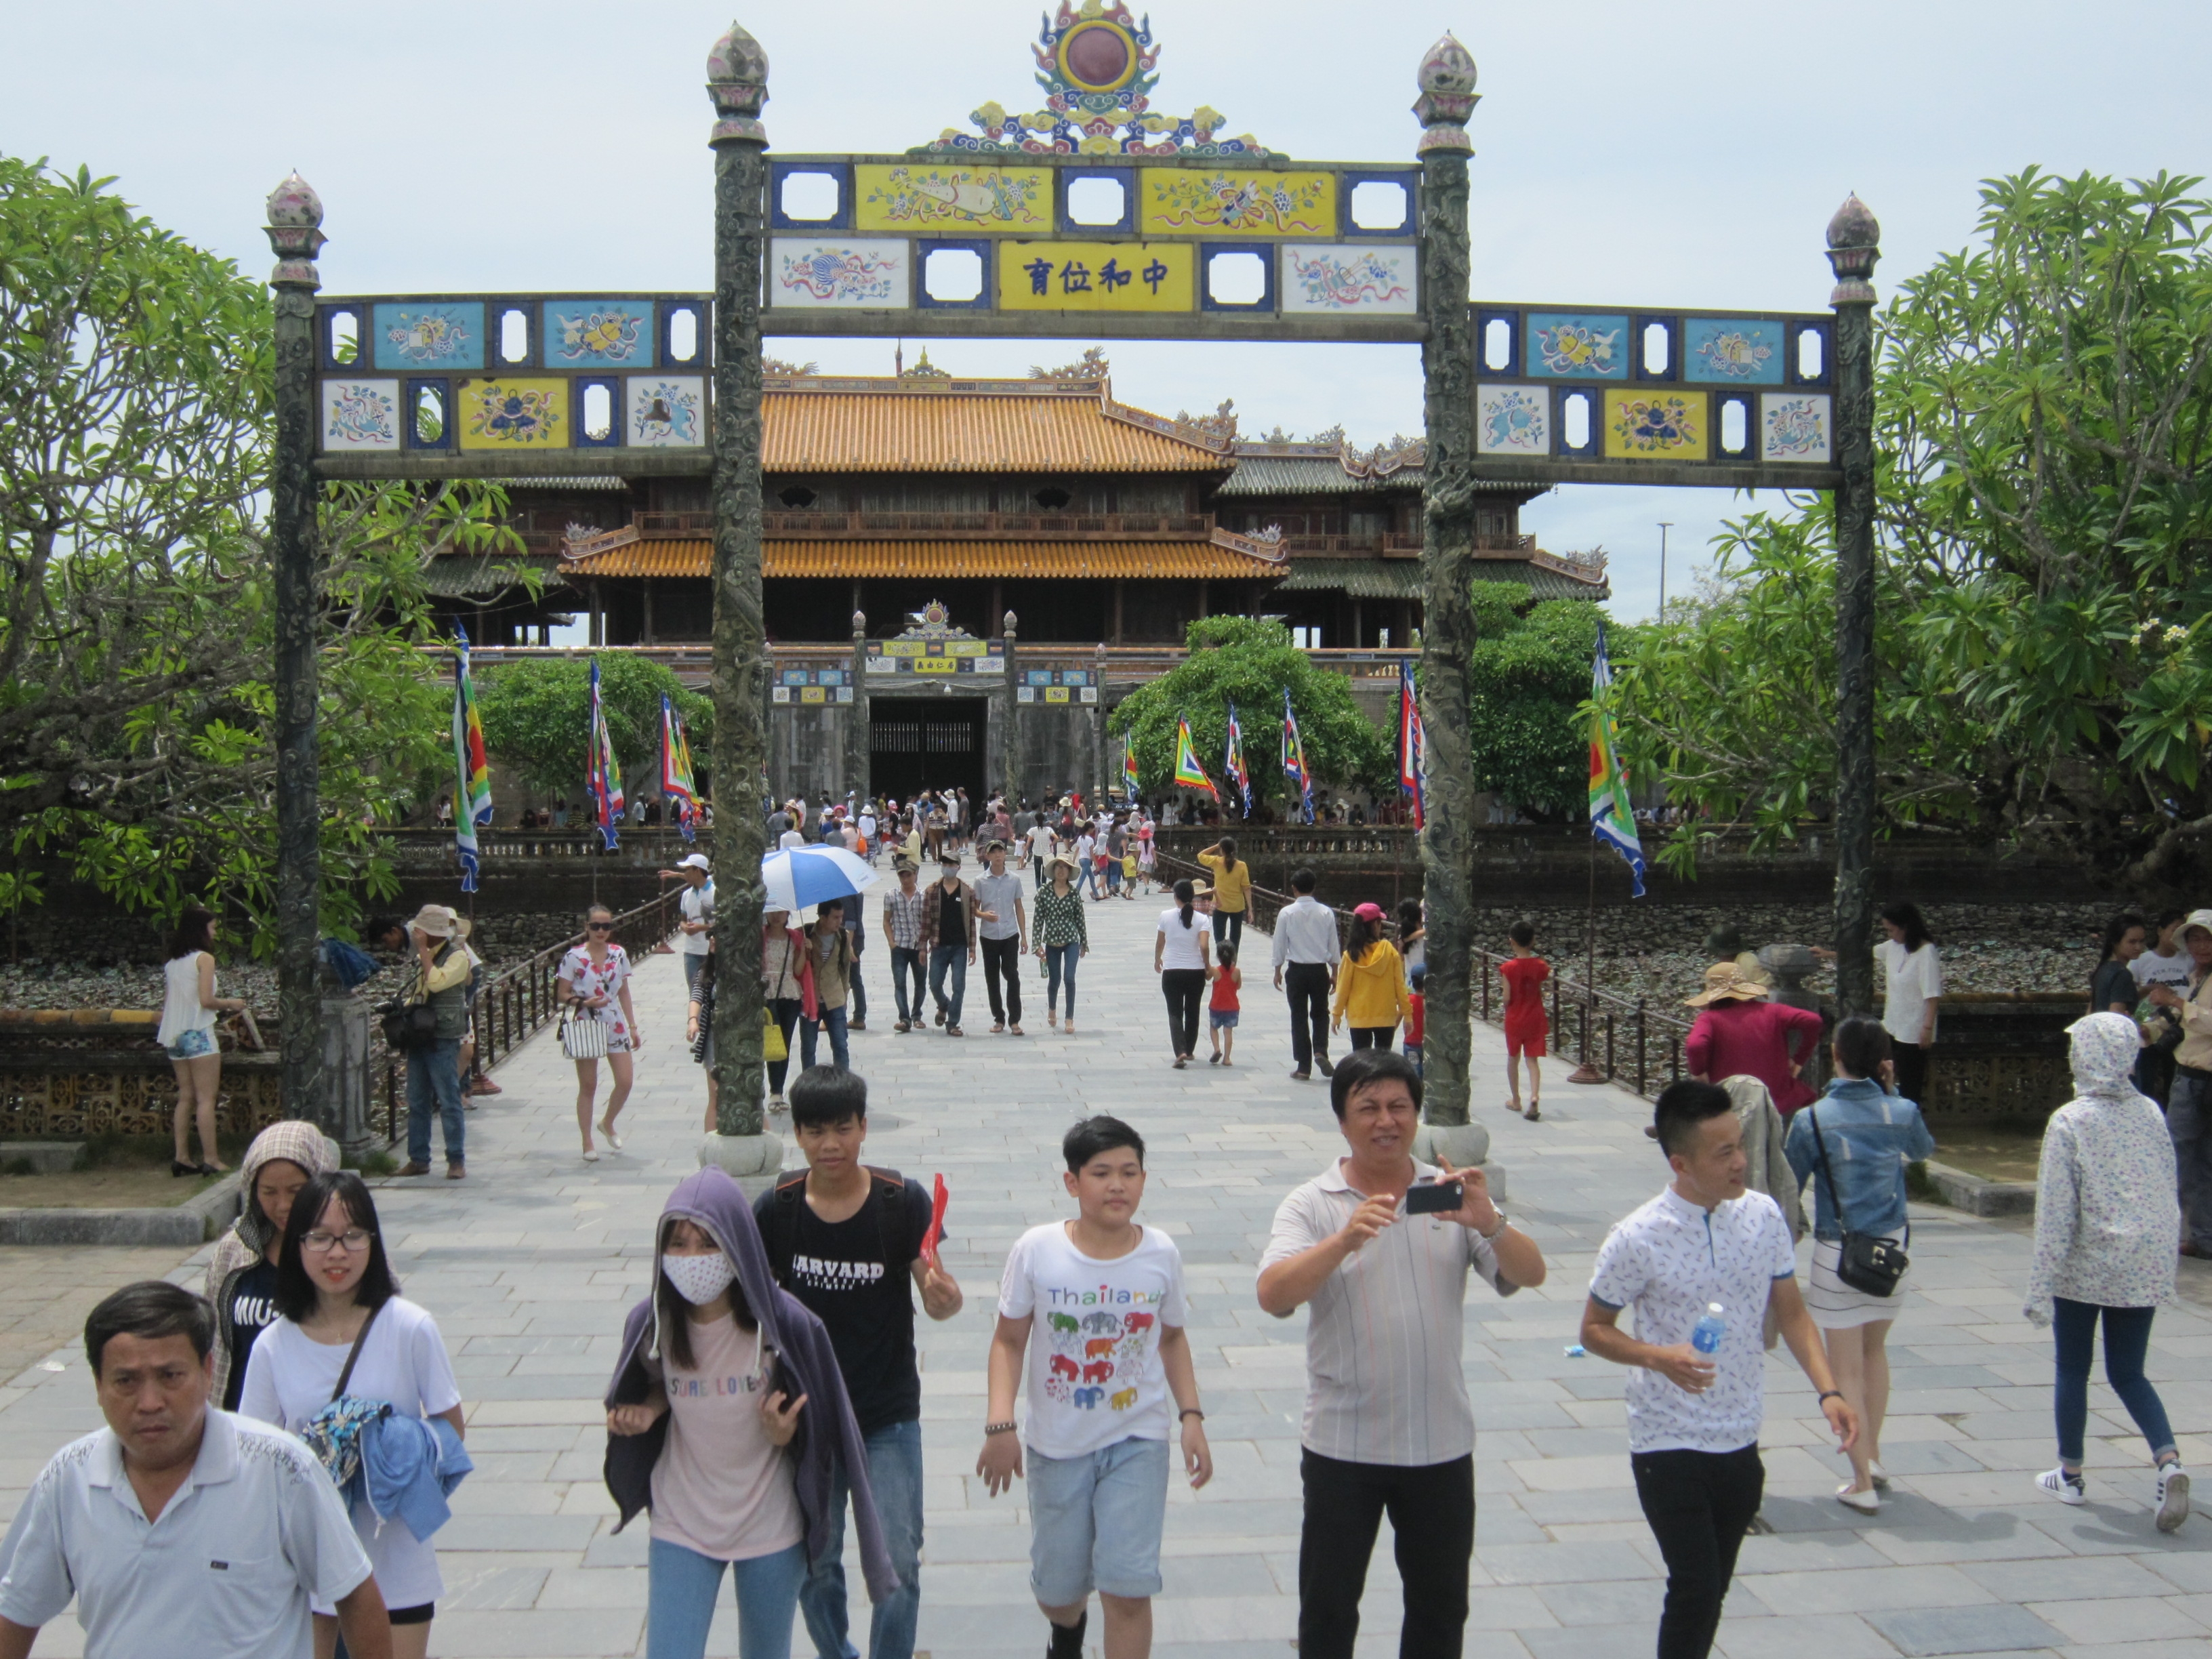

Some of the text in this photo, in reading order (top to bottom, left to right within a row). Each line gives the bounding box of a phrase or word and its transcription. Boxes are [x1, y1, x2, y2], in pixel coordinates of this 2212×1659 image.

[792, 1254, 884, 1279] ARVARD
[792, 1269, 877, 1286] NIVERSITY
[1048, 1284, 1162, 1307] Thailand
[668, 1377, 708, 1397] SURE
